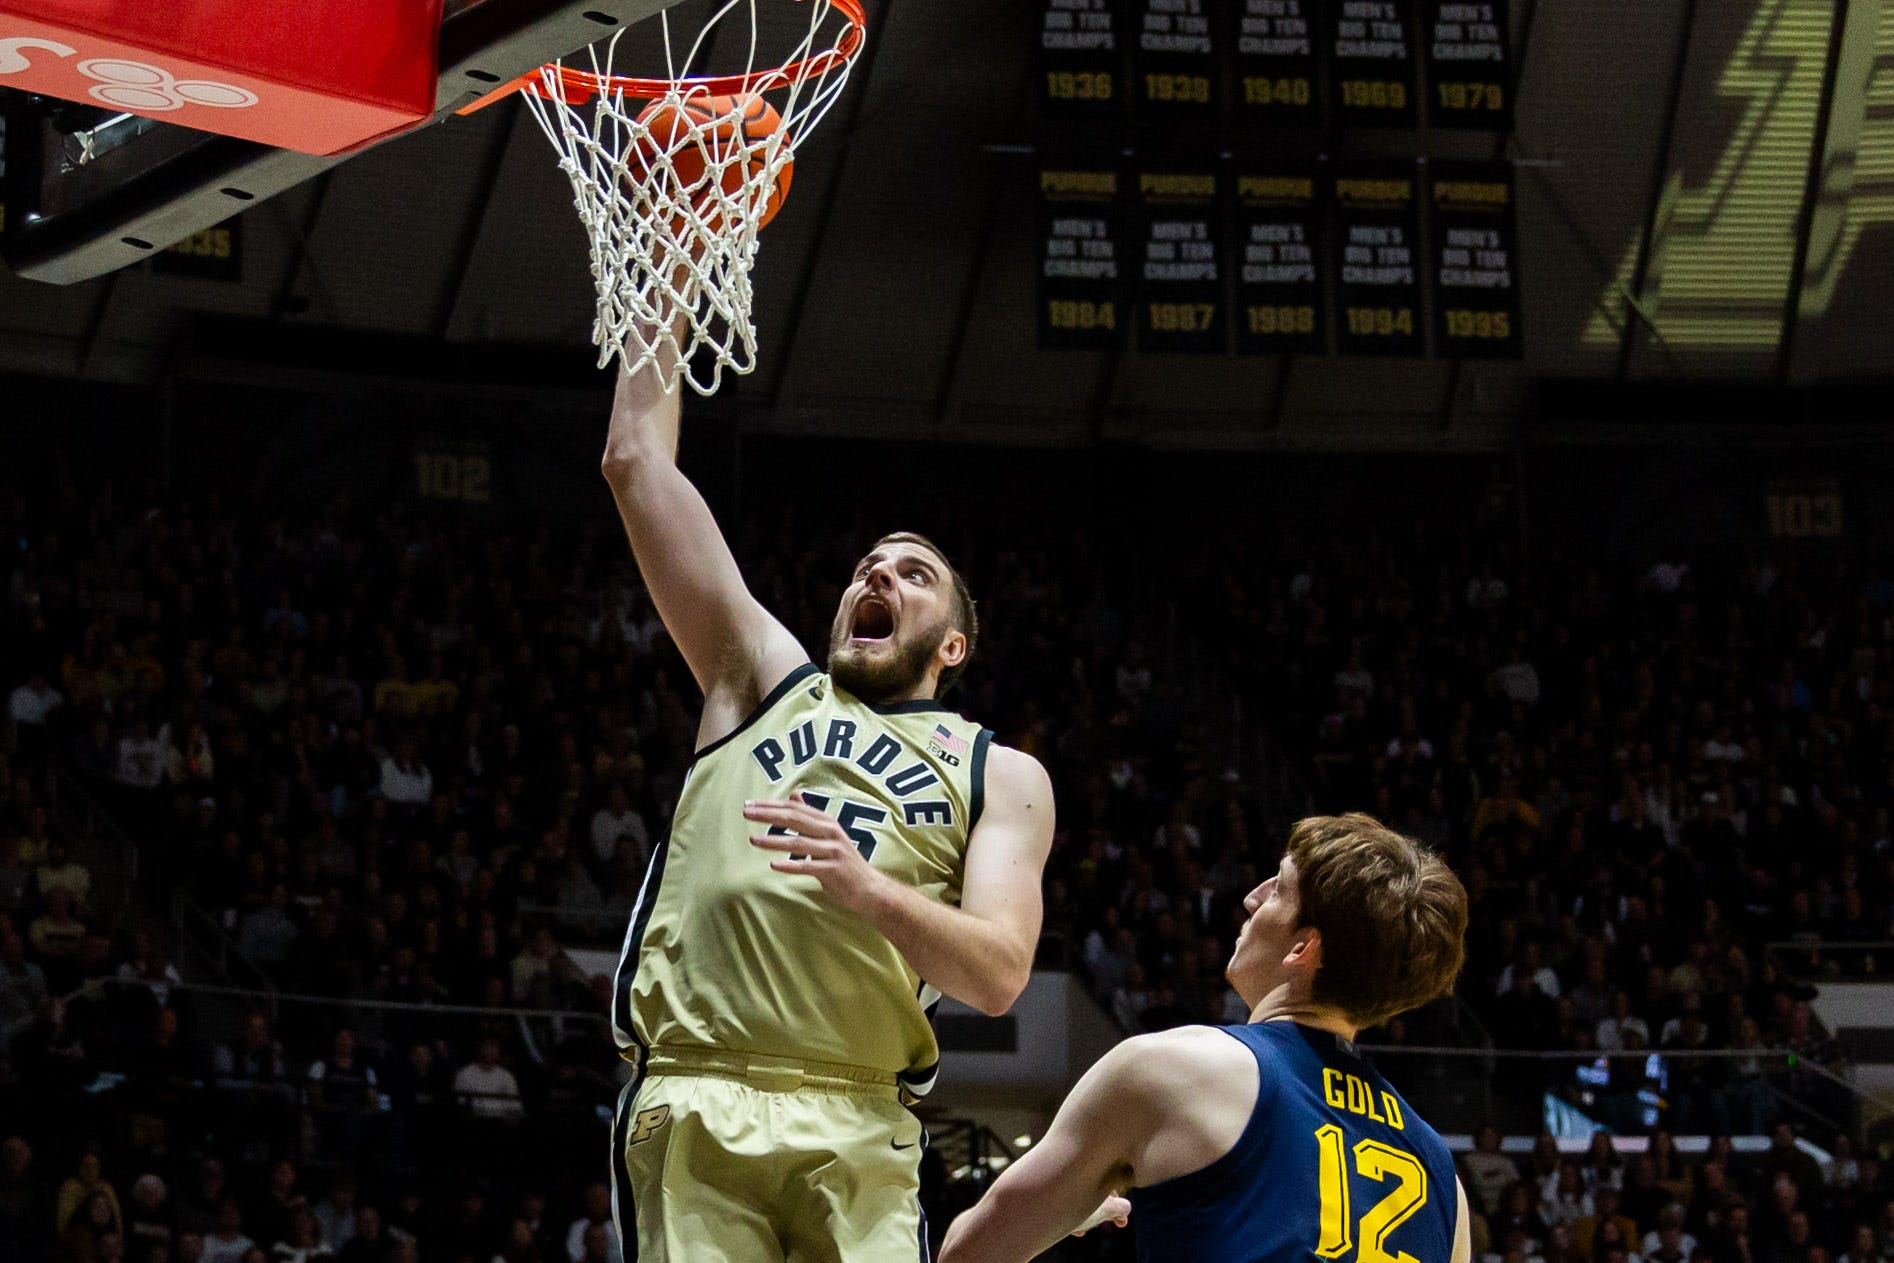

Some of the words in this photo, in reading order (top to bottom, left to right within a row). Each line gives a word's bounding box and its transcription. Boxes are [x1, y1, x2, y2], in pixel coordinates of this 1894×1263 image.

[1048, 73, 1111, 98] 1936
[1244, 78, 1309, 105] 1940
[1342, 81, 1405, 107] 1969
[1439, 83, 1502, 109] 1979
[1050, 301, 1115, 328] 1984
[1150, 304, 1214, 330] 1987
[1348, 308, 1412, 334] 1994
[1446, 310, 1509, 337] 1995
[415, 456, 489, 500] 102
[1766, 494, 1841, 536] 103
[752, 716, 953, 829] PURDUE
[1322, 1066, 1405, 1131] GOLD
[1314, 1123, 1428, 1263] 12
